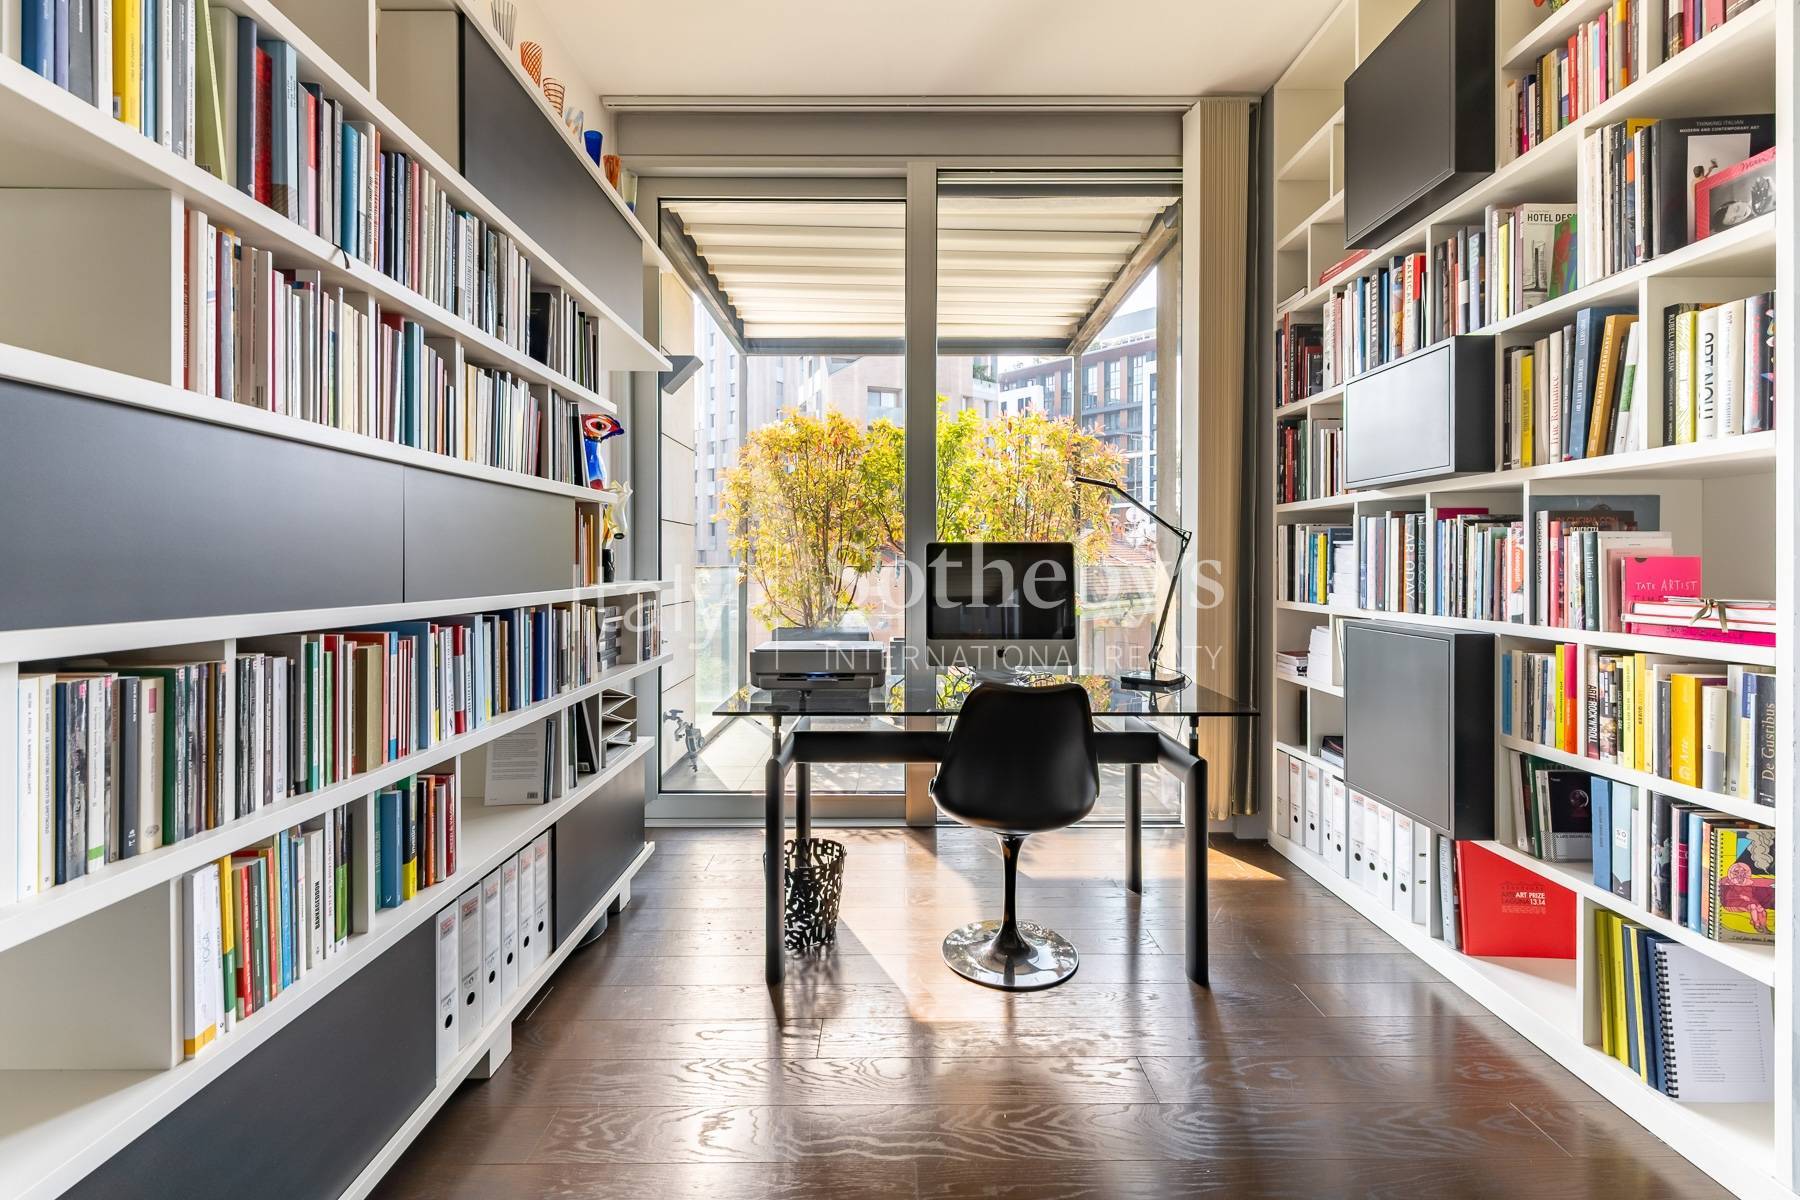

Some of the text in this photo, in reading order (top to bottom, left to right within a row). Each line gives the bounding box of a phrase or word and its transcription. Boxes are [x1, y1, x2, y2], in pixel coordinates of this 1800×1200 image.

[1527, 213, 1577, 223] HOTEL DES
[1551, 375, 1560, 422] Romance
[1635, 579, 1698, 593] TATE ARTIST
[1761, 703, 1775, 781] De Gustibus
